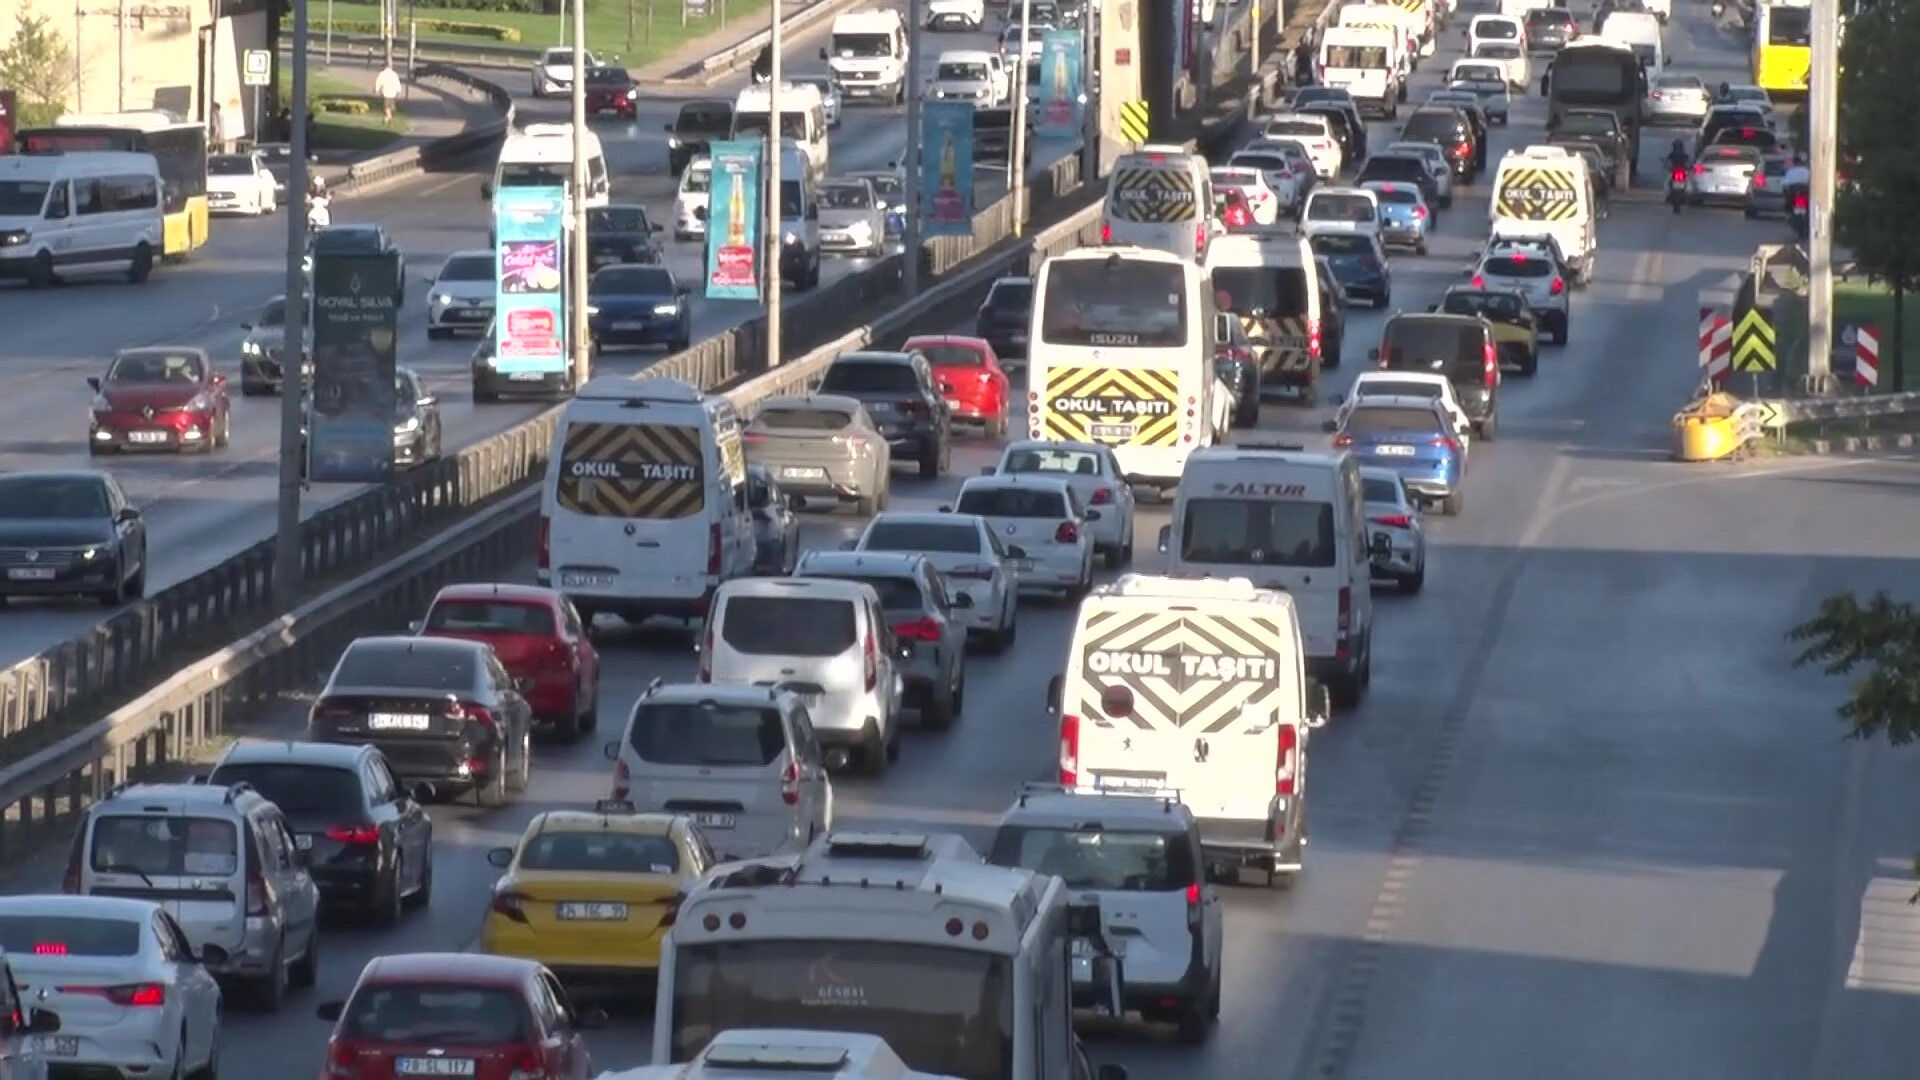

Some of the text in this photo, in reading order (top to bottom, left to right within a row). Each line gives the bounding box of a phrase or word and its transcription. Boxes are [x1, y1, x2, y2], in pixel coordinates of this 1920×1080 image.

[1090, 334, 1139, 345] ISUZU
[1055, 398, 1169, 415] OKUL TAŞITI
[571, 463, 695, 482] OKUL TAŞITI
[1229, 482, 1306, 497] ALTUR
[1088, 651, 1275, 682] OKUL TAŞITI
